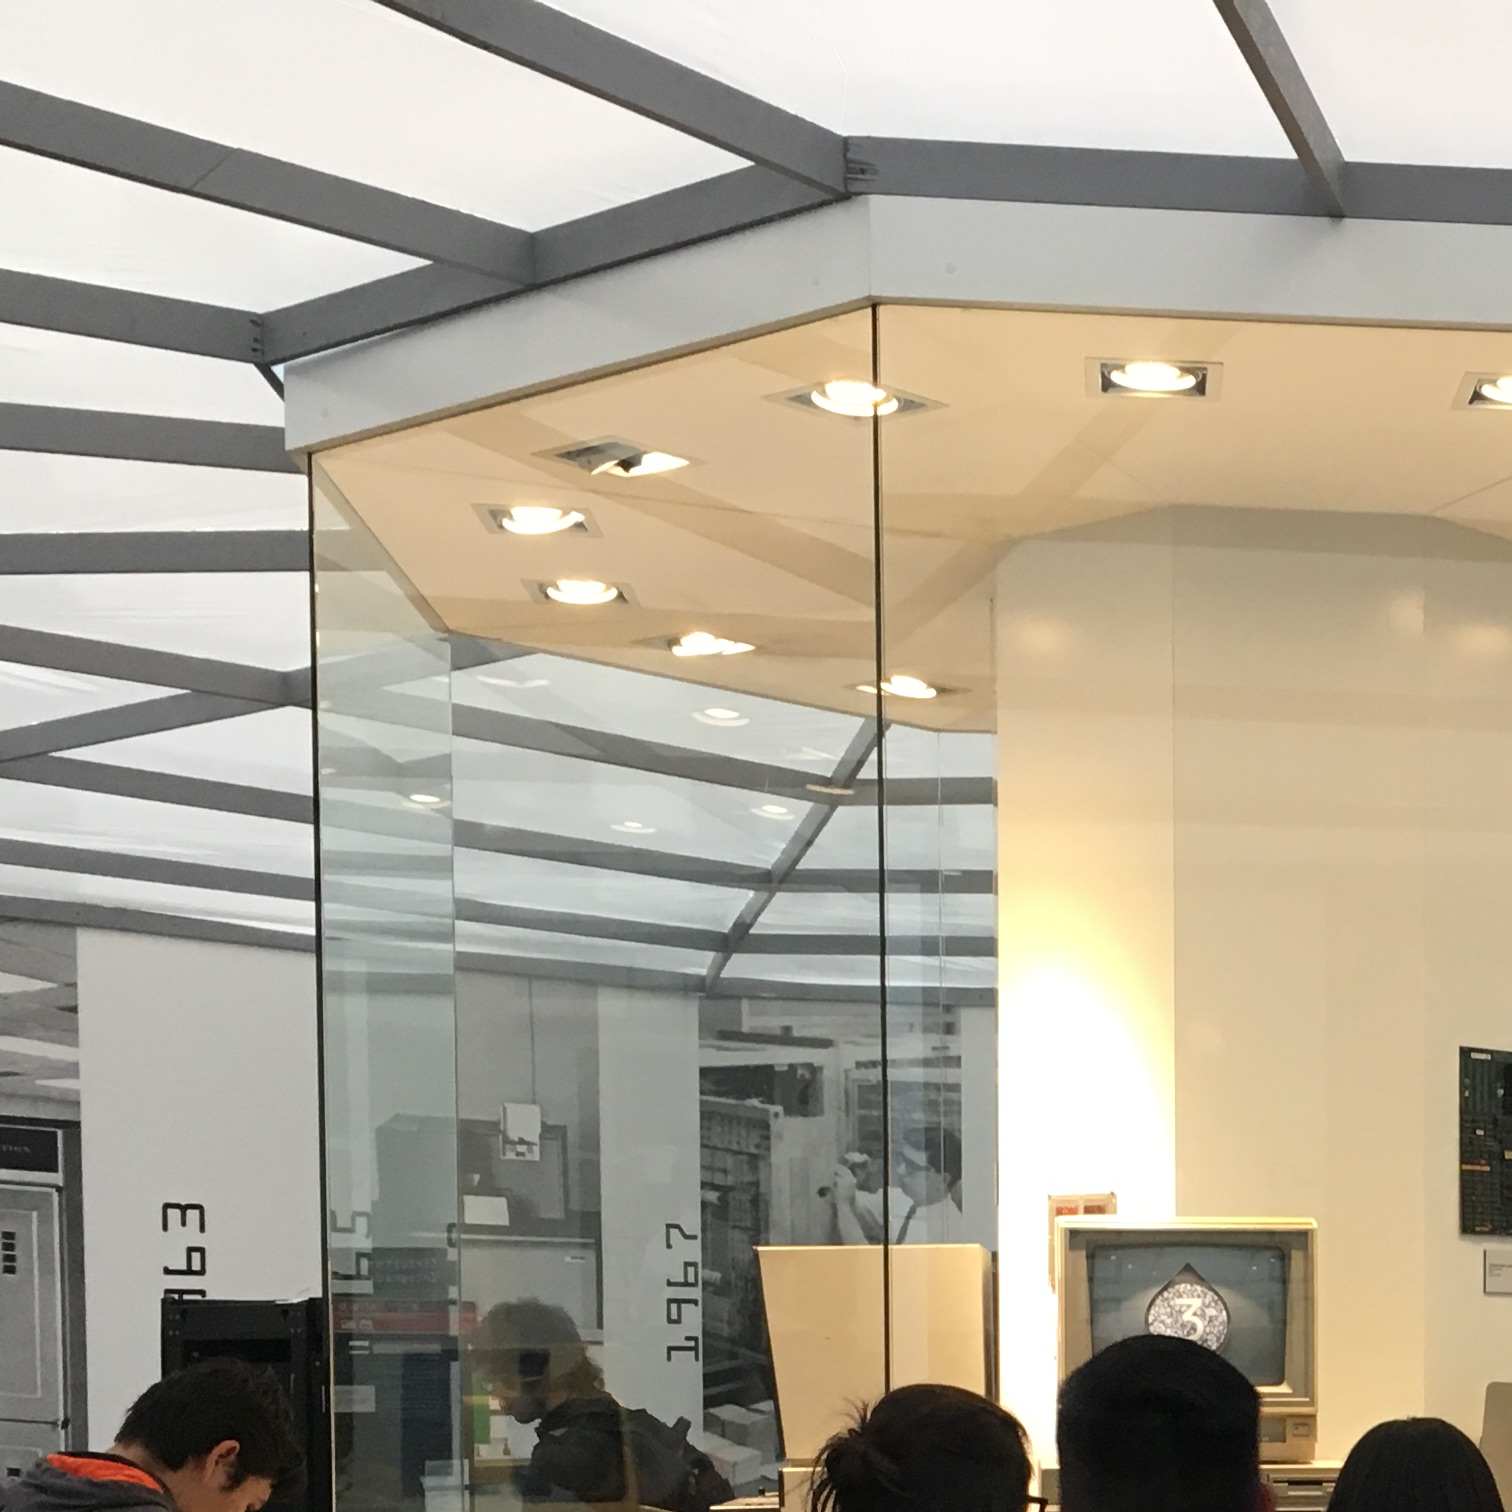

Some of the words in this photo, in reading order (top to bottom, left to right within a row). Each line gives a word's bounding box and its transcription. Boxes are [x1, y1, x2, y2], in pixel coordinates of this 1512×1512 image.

[162, 1202, 206, 1300] 63
[665, 1223, 699, 1362] 1967
[1174, 1298, 1204, 1341] 3
